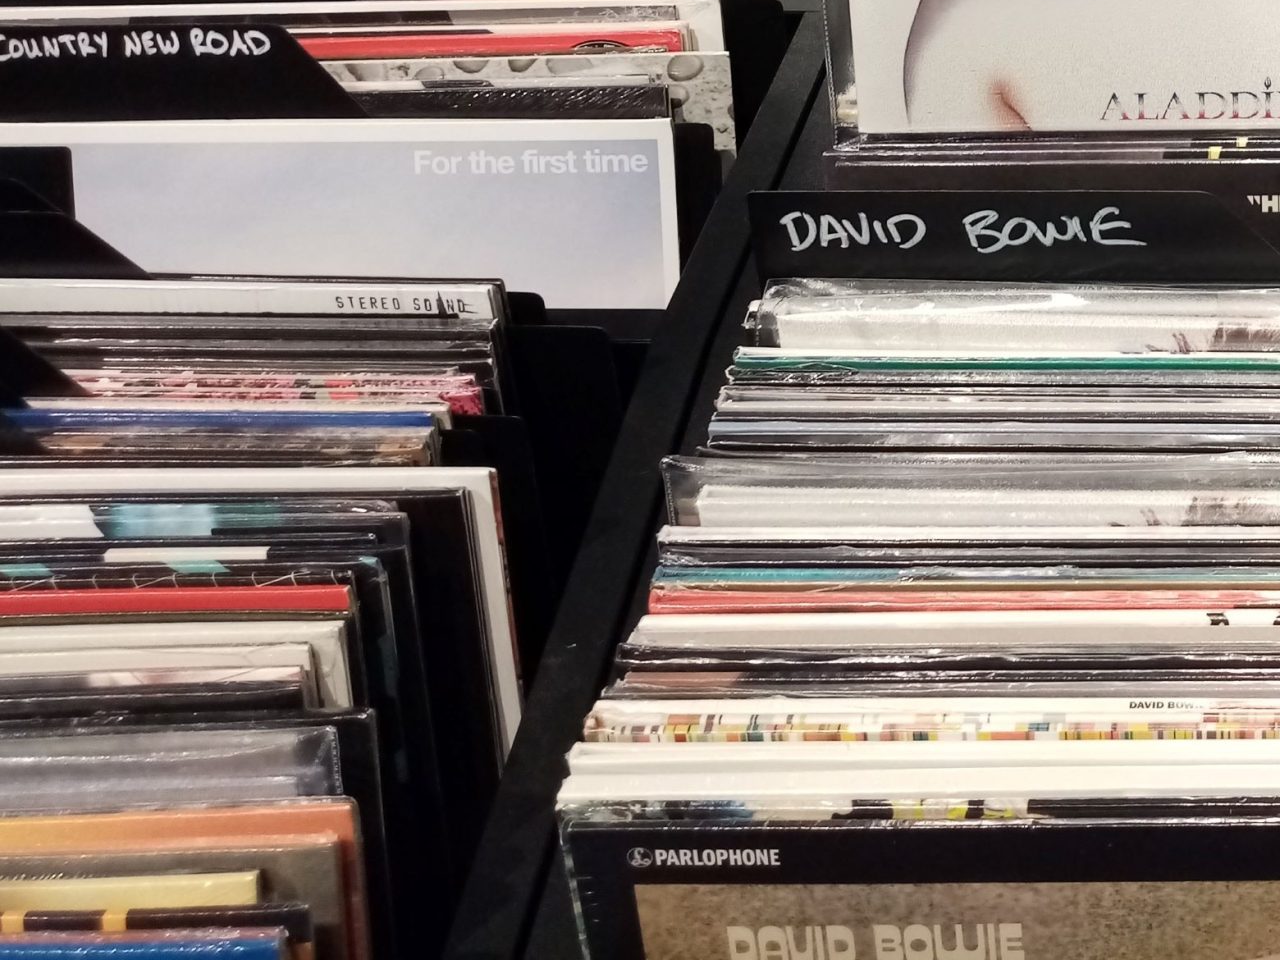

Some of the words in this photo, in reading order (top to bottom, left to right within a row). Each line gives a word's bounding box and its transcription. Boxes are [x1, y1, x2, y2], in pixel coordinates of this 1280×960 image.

[124, 29, 181, 56] NEW
[190, 27, 272, 57] ROAD
[414, 150, 462, 175] For
[468, 150, 515, 174] the
[521, 149, 577, 174] first
[583, 149, 649, 173] time
[779, 211, 926, 251] DAVID
[962, 206, 1147, 253] BOWIE
[335, 295, 401, 311] STEREO
[1129, 701, 1164, 709] DAVID
[655, 849, 781, 866] PARLOPHONE
[727, 926, 857, 960] DAVID
[872, 923, 1026, 960] BOWIE
